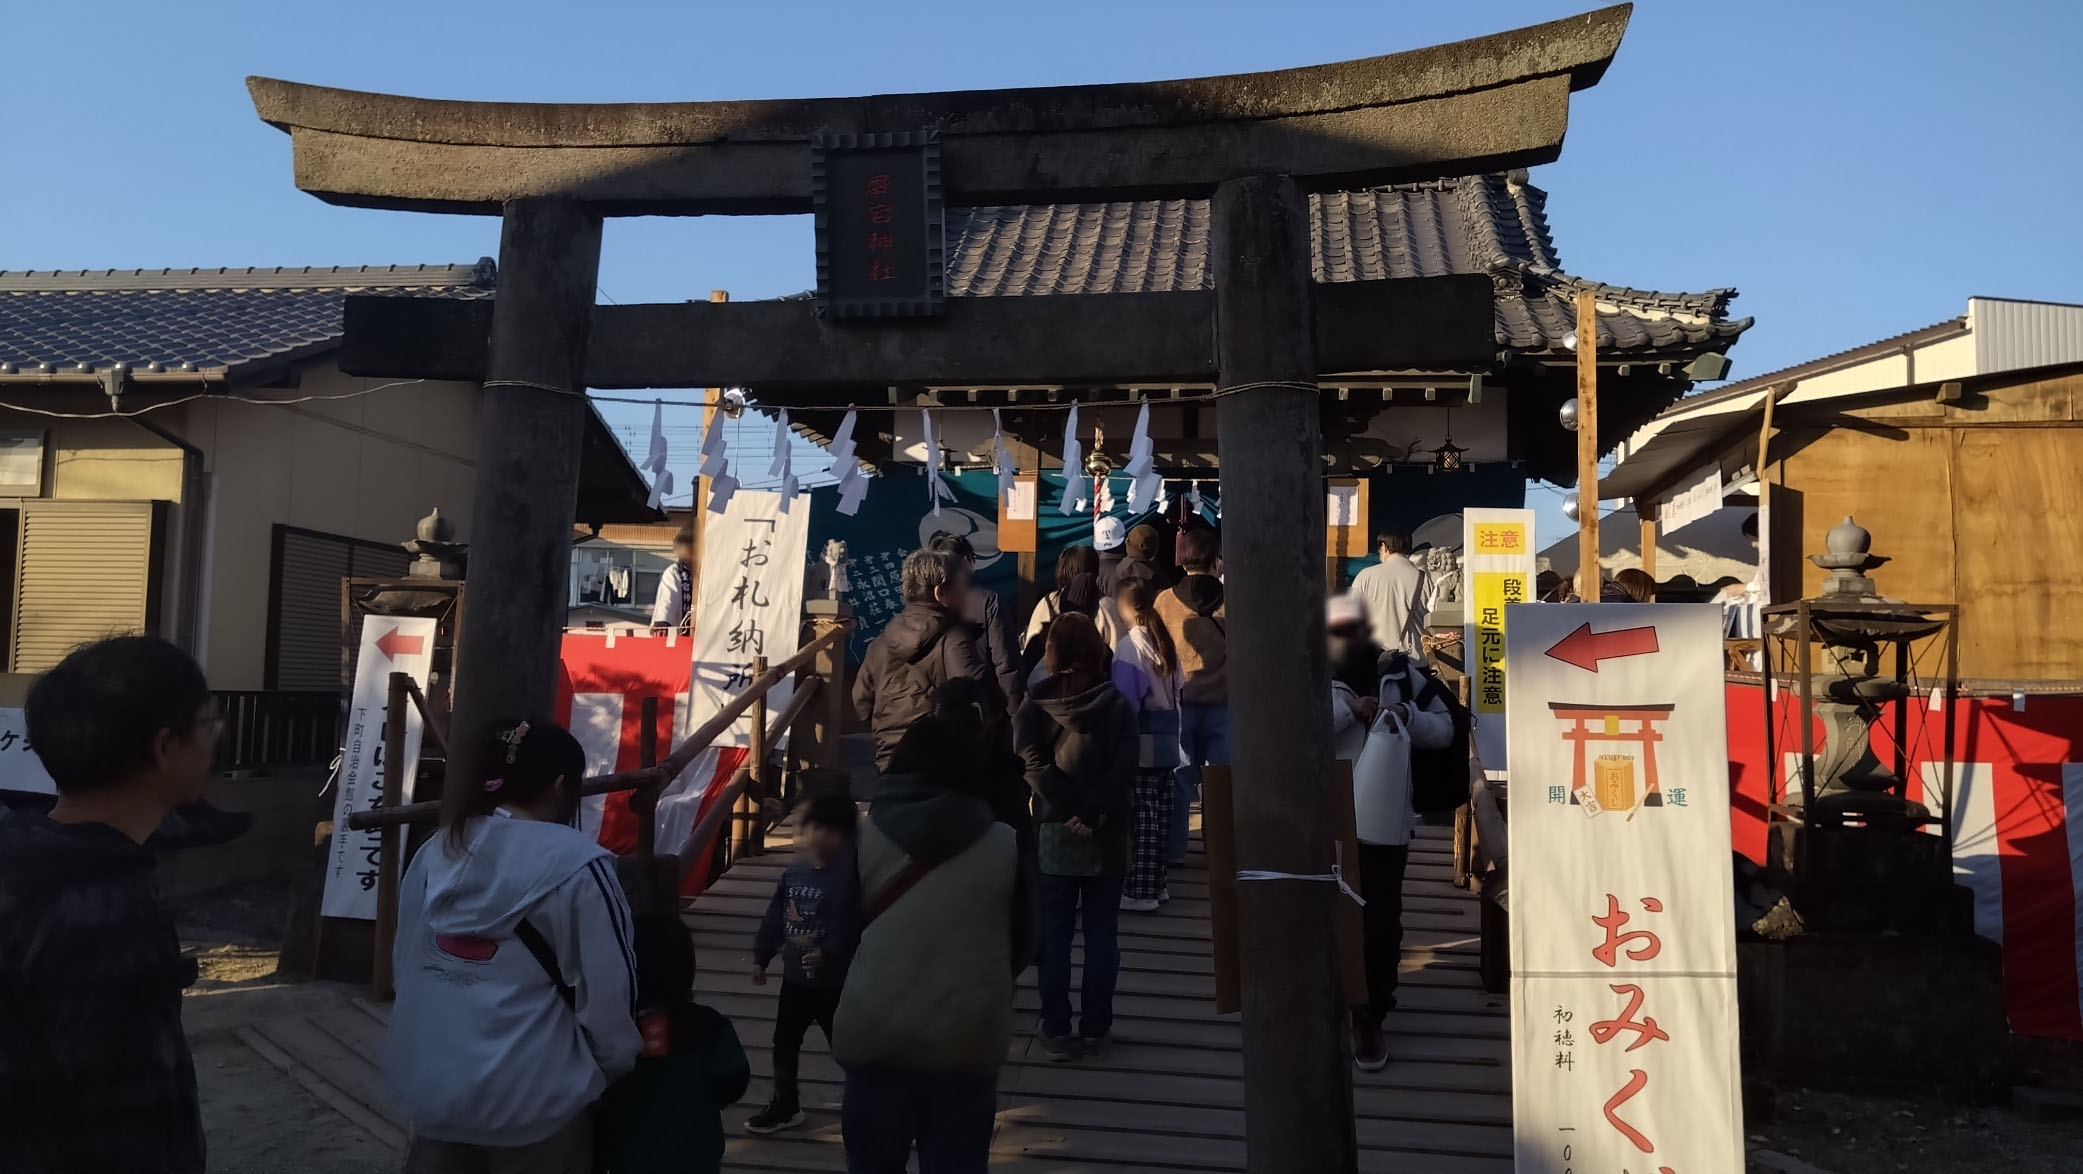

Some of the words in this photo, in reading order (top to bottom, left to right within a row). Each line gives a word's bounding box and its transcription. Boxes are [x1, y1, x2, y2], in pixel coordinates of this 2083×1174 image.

[1480, 530, 1519, 549] 注意
[1481, 608, 1503, 705] 足元に注意
[1548, 785, 1566, 805] 開
[1666, 787, 1689, 807] 運
[1580, 790, 1598, 814] 大吉
[1552, 1004, 1576, 1072] 初穂料
[1588, 893, 1676, 1174] おみく
